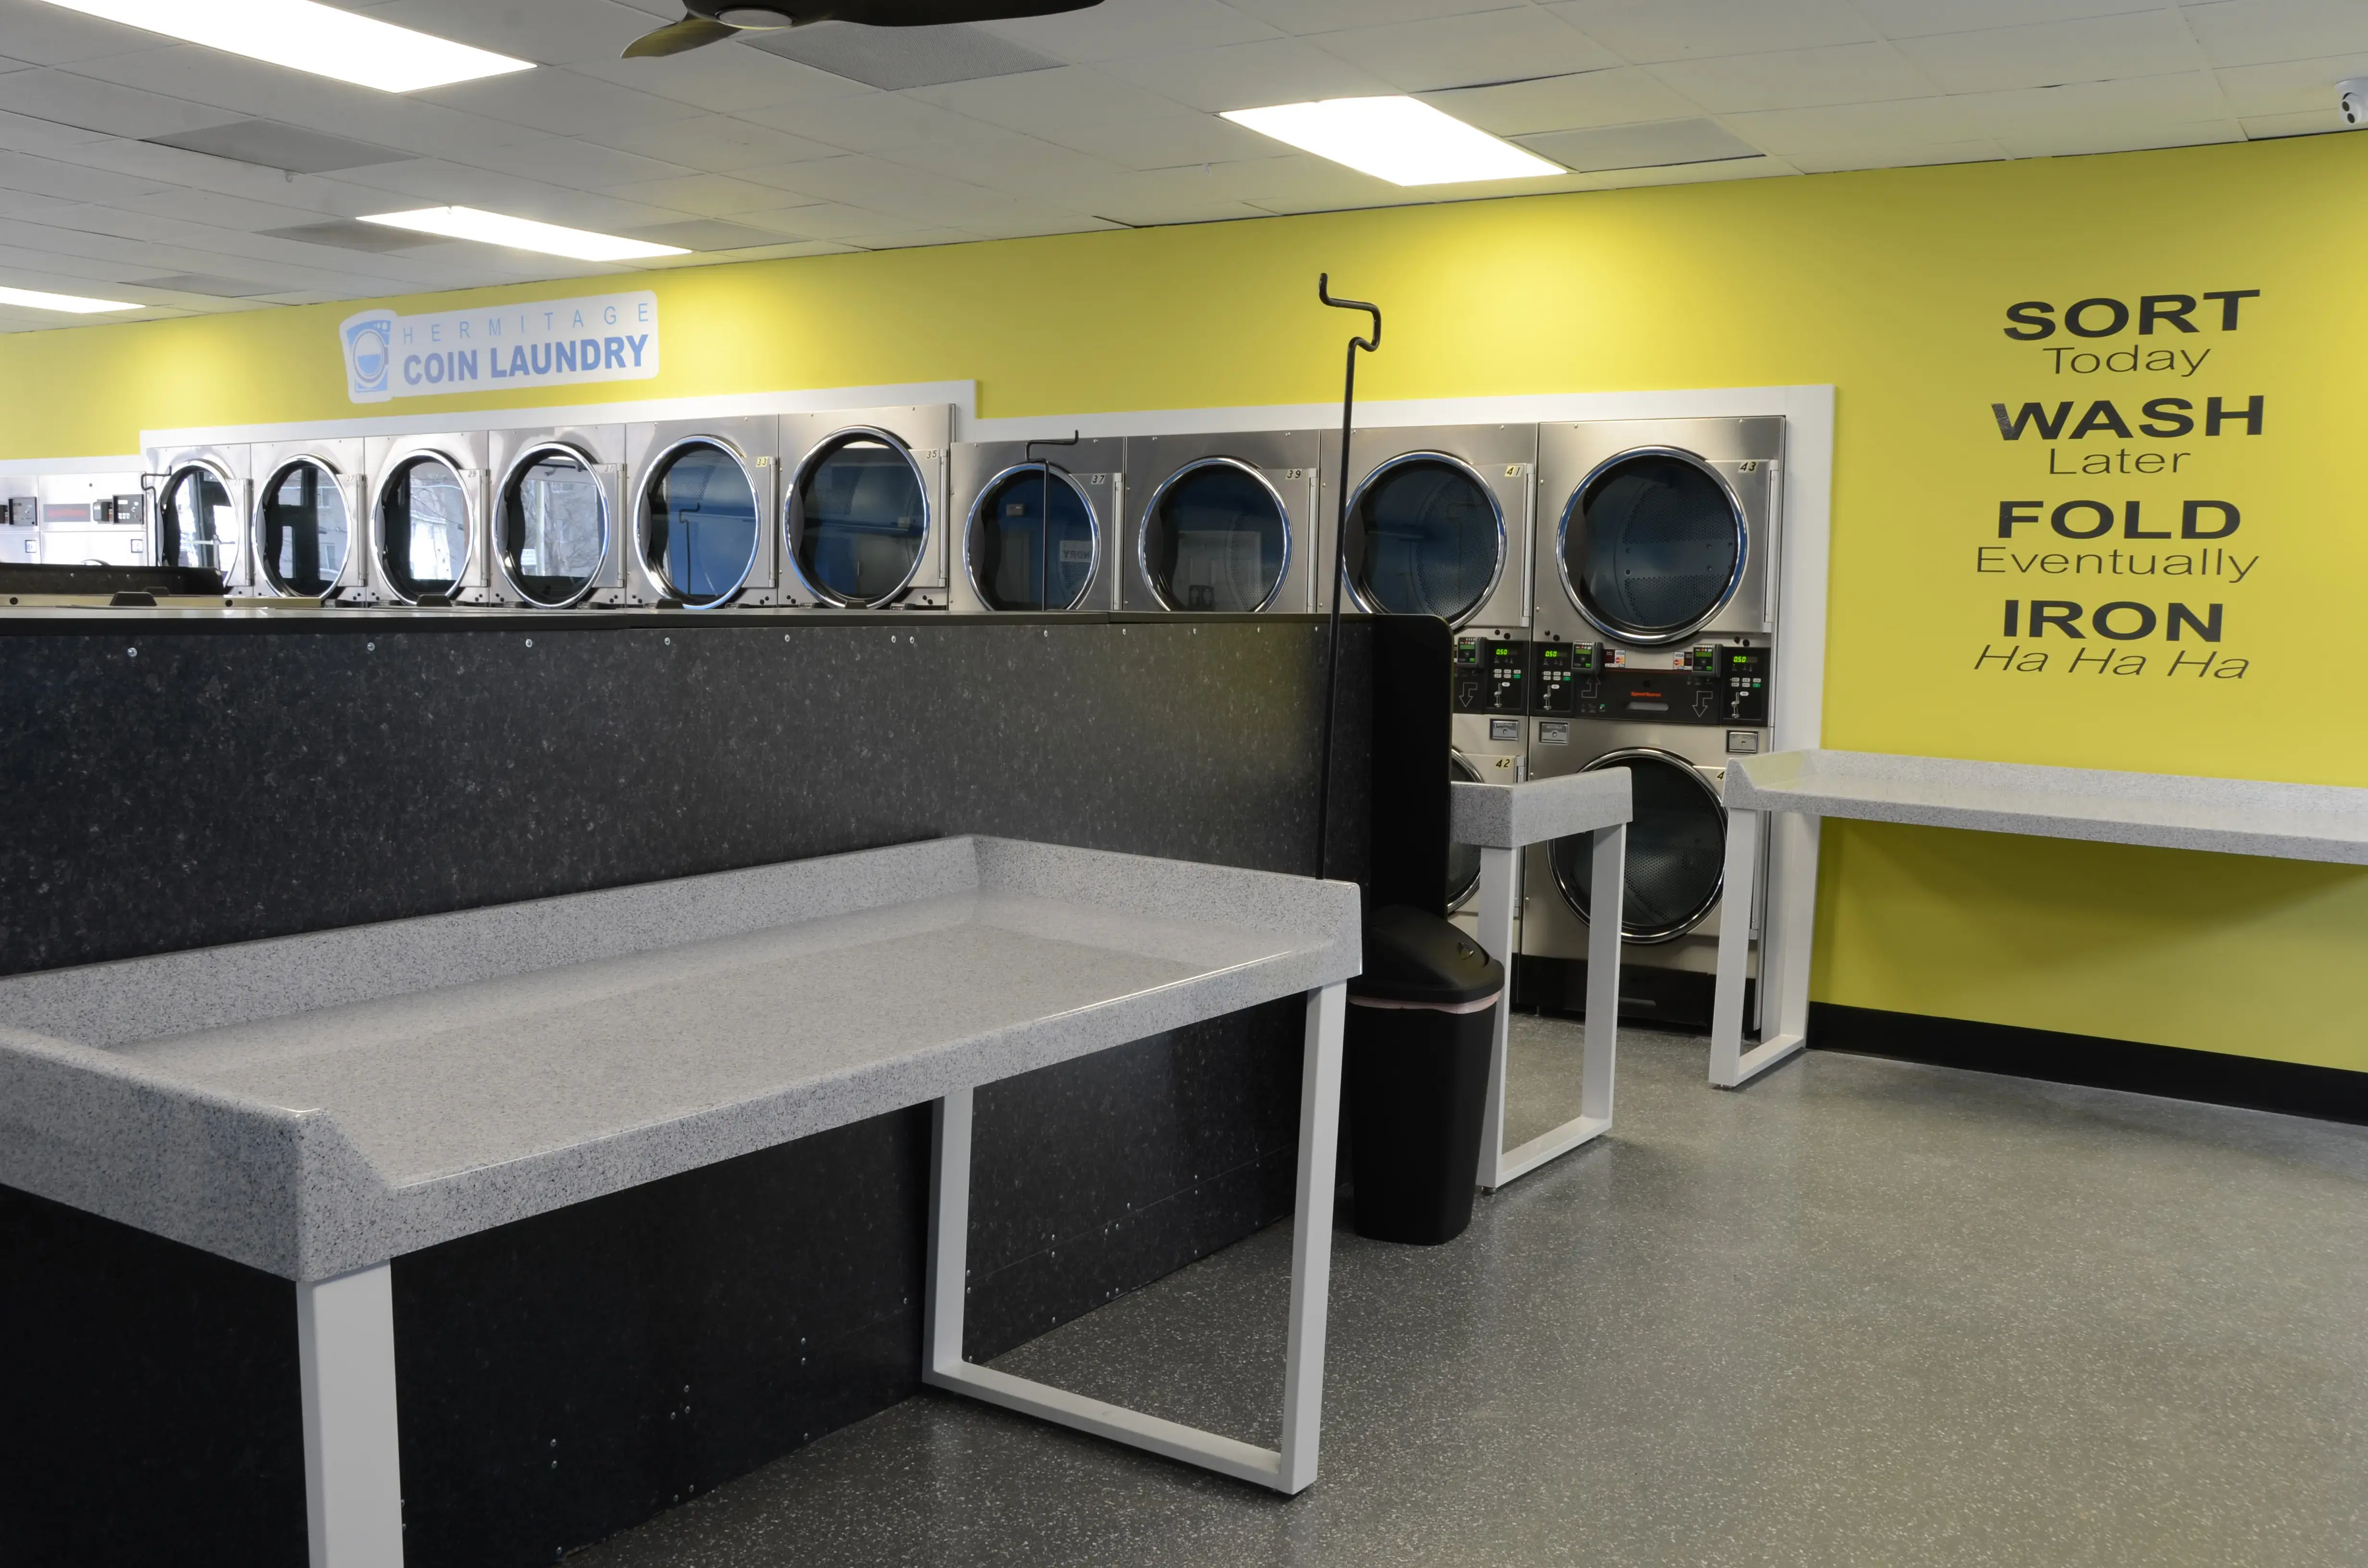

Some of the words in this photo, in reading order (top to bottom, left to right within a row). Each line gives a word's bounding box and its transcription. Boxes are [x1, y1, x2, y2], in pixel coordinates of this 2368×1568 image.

[403, 303, 648, 344] HERMITAGE
[2003, 289, 2260, 341] SORT
[404, 349, 478, 385] COIN
[490, 334, 649, 379] LAUNDRY
[2042, 344, 2211, 377] Today
[1991, 395, 2264, 441] WASH
[926, 450, 937, 459] 35
[1740, 462, 1756, 472] 43
[2049, 448, 2191, 475] Later
[1092, 475, 1105, 483] 37
[1287, 470, 1301, 478] 39
[1506, 467, 1520, 476] 41
[1998, 500, 2241, 539] FOLD
[1977, 547, 2259, 583] Eventually
[2003, 600, 2223, 642] IRON
[1974, 645, 2049, 672] Ha
[2068, 647, 2147, 675] Ha
[2167, 650, 2250, 679] Ha
[1495, 759, 1510, 768] 42
